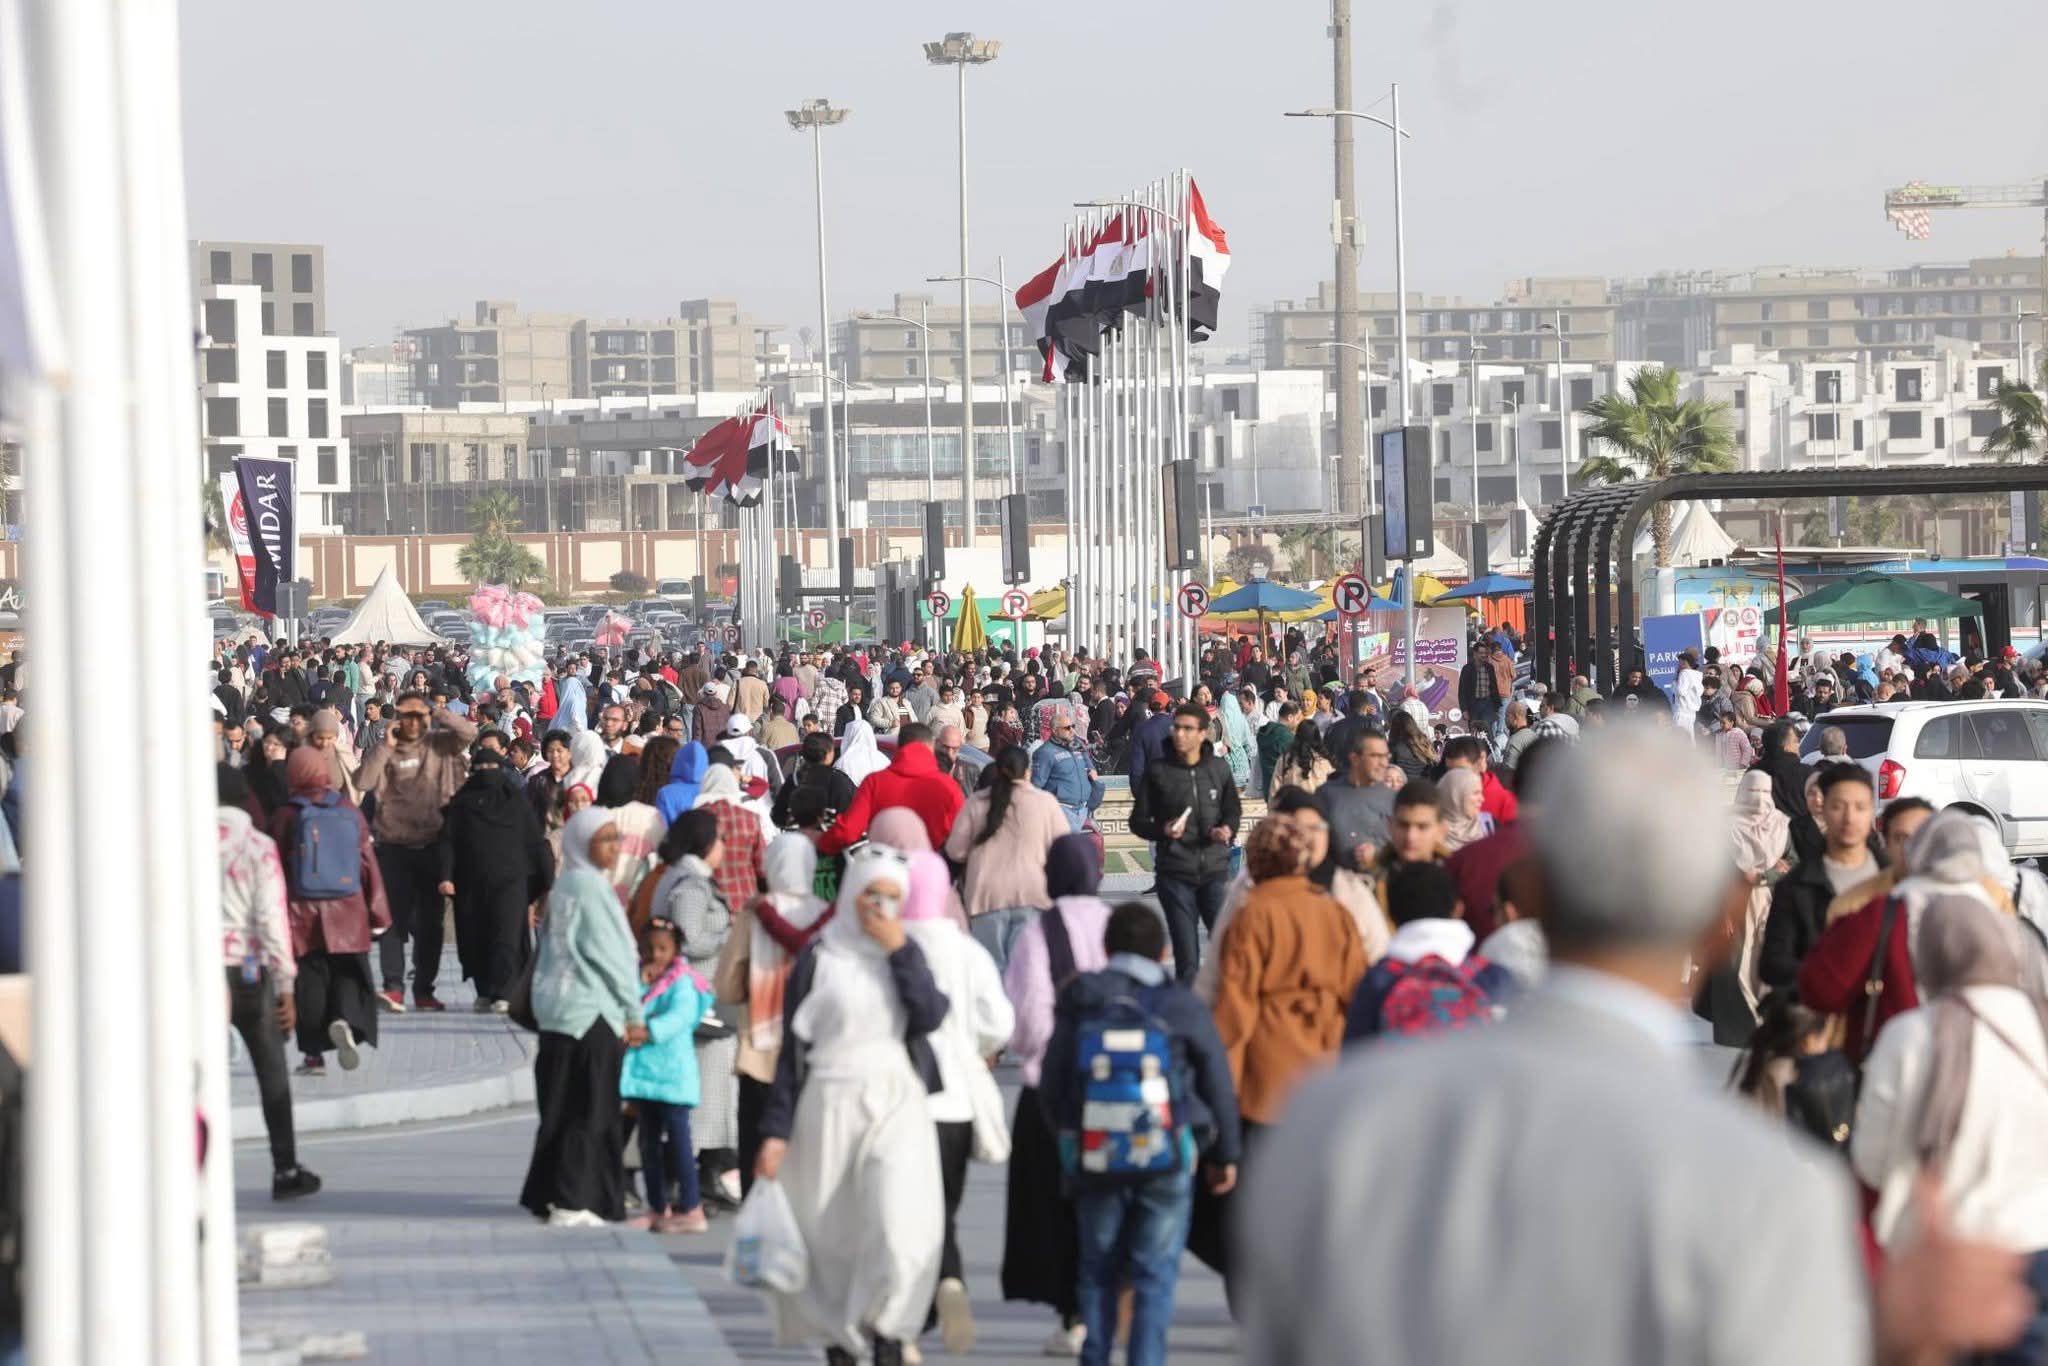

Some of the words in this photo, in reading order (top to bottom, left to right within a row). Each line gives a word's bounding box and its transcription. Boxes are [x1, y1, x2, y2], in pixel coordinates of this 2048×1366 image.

[932, 596, 946, 614] P
[1009, 595, 1025, 615] P
[1187, 588, 1204, 613] P
[1344, 582, 1365, 610] P
